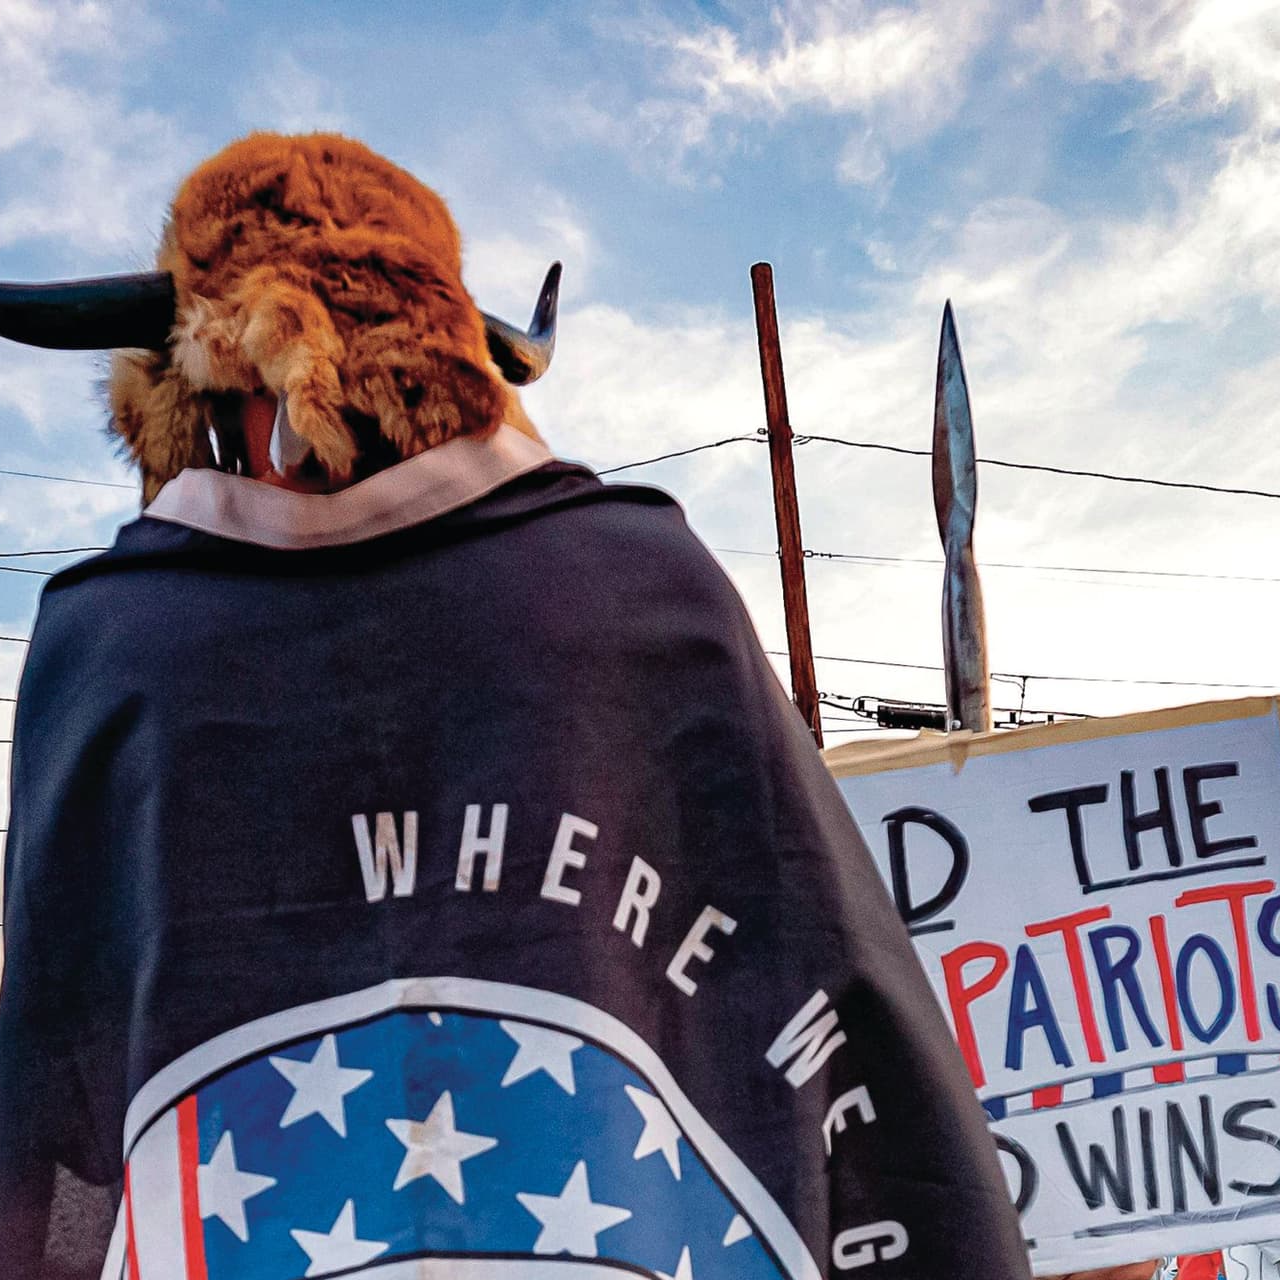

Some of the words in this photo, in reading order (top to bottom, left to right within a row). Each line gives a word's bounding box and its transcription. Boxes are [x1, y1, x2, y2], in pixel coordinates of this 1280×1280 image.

[1027, 760, 1259, 890] THE
[351, 803, 737, 998] WHERE
[764, 988, 877, 1156] WE
